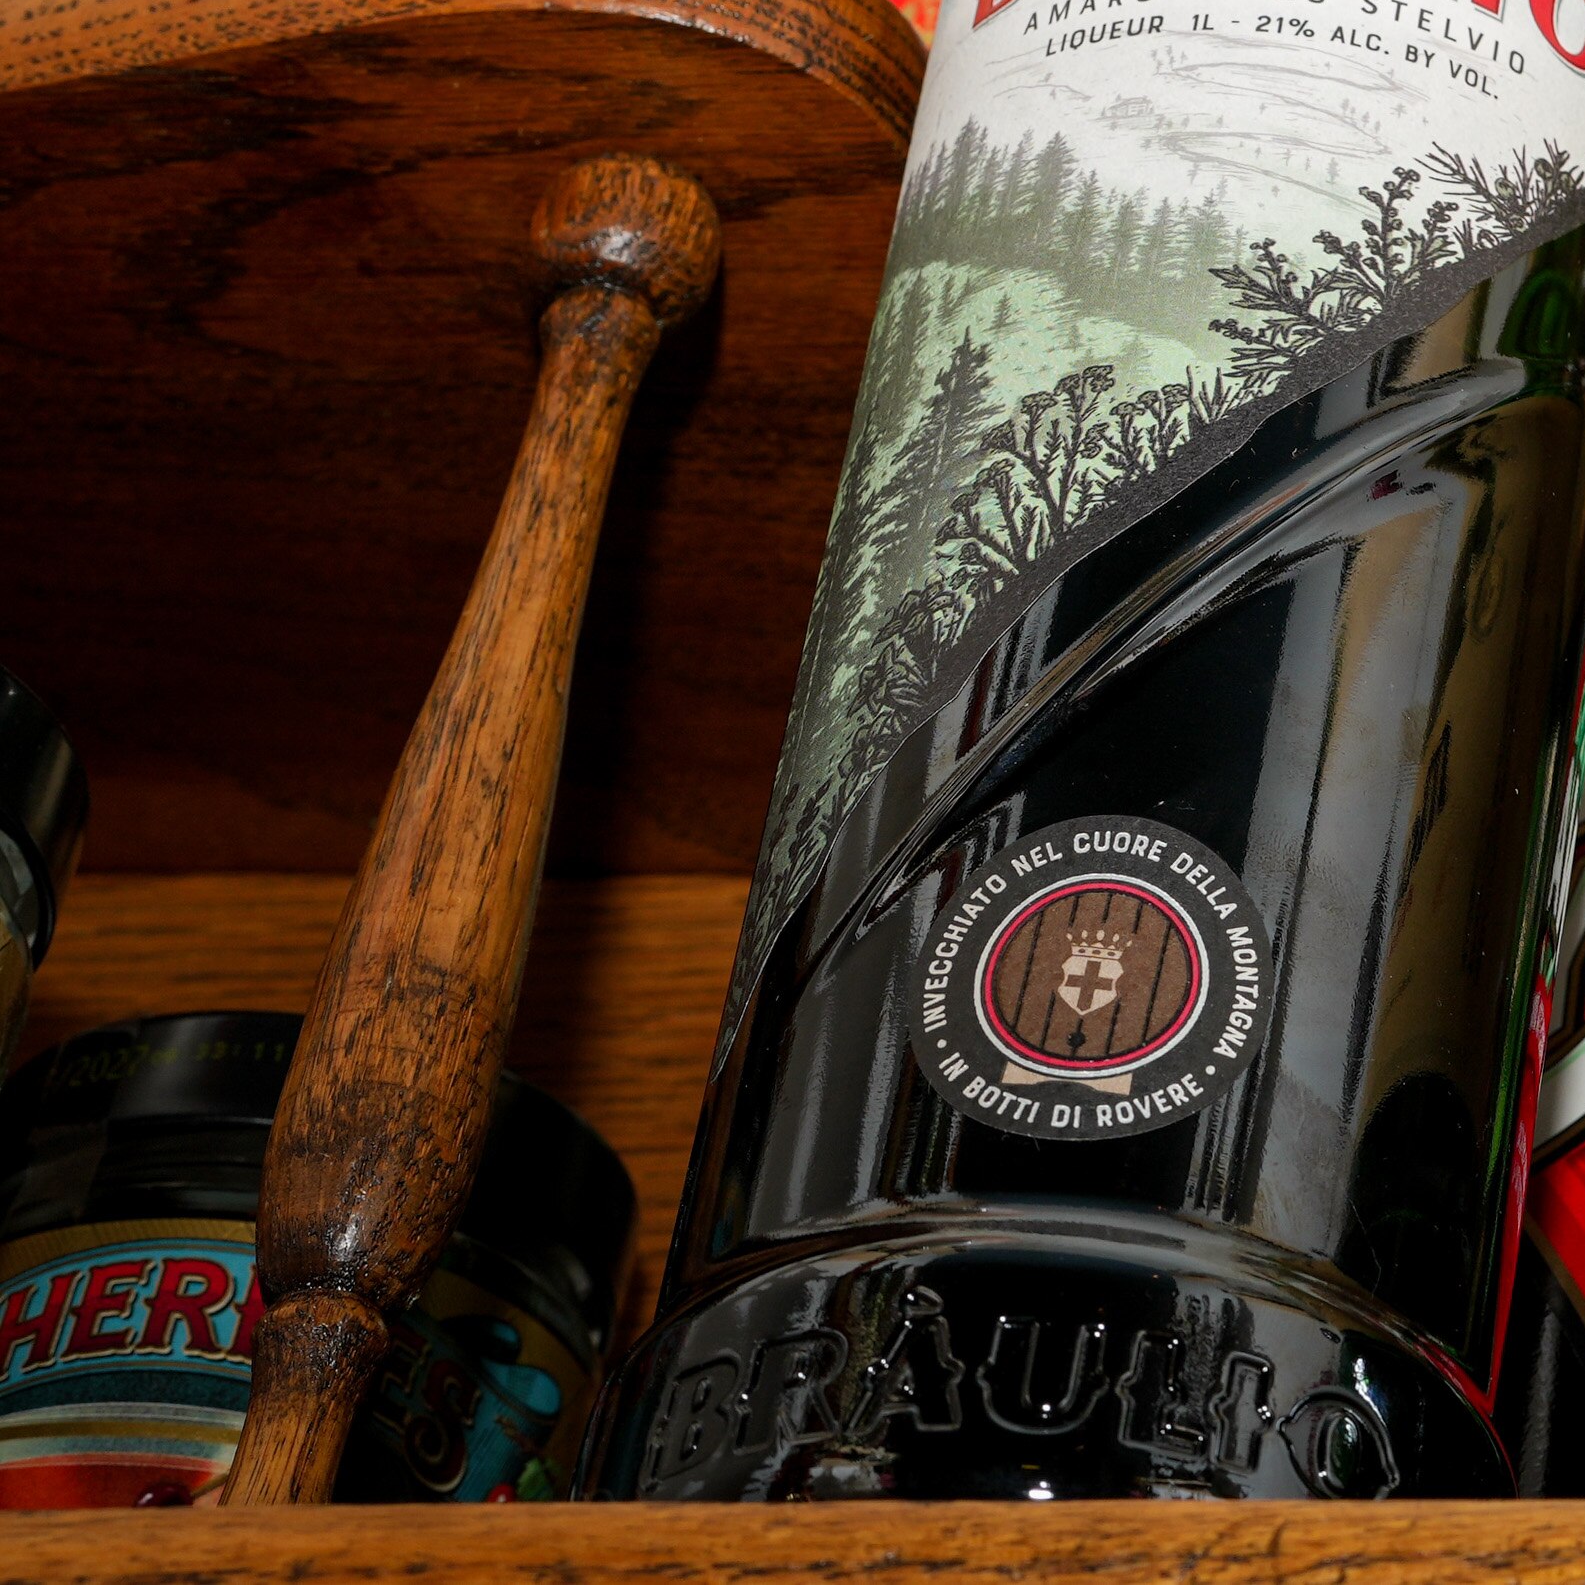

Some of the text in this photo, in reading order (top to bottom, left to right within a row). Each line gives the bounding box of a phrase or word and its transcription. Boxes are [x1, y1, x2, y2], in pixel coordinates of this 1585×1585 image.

[1044, 14, 1500, 100] LIQUEUR 1L 21% ALC. BY VOL.
[922, 830, 1260, 1060] INVECCHIATO NEL CUORE DELLA MONTAGNA
[938, 1051, 1205, 1129] IN BOTTI DI ROVERE
